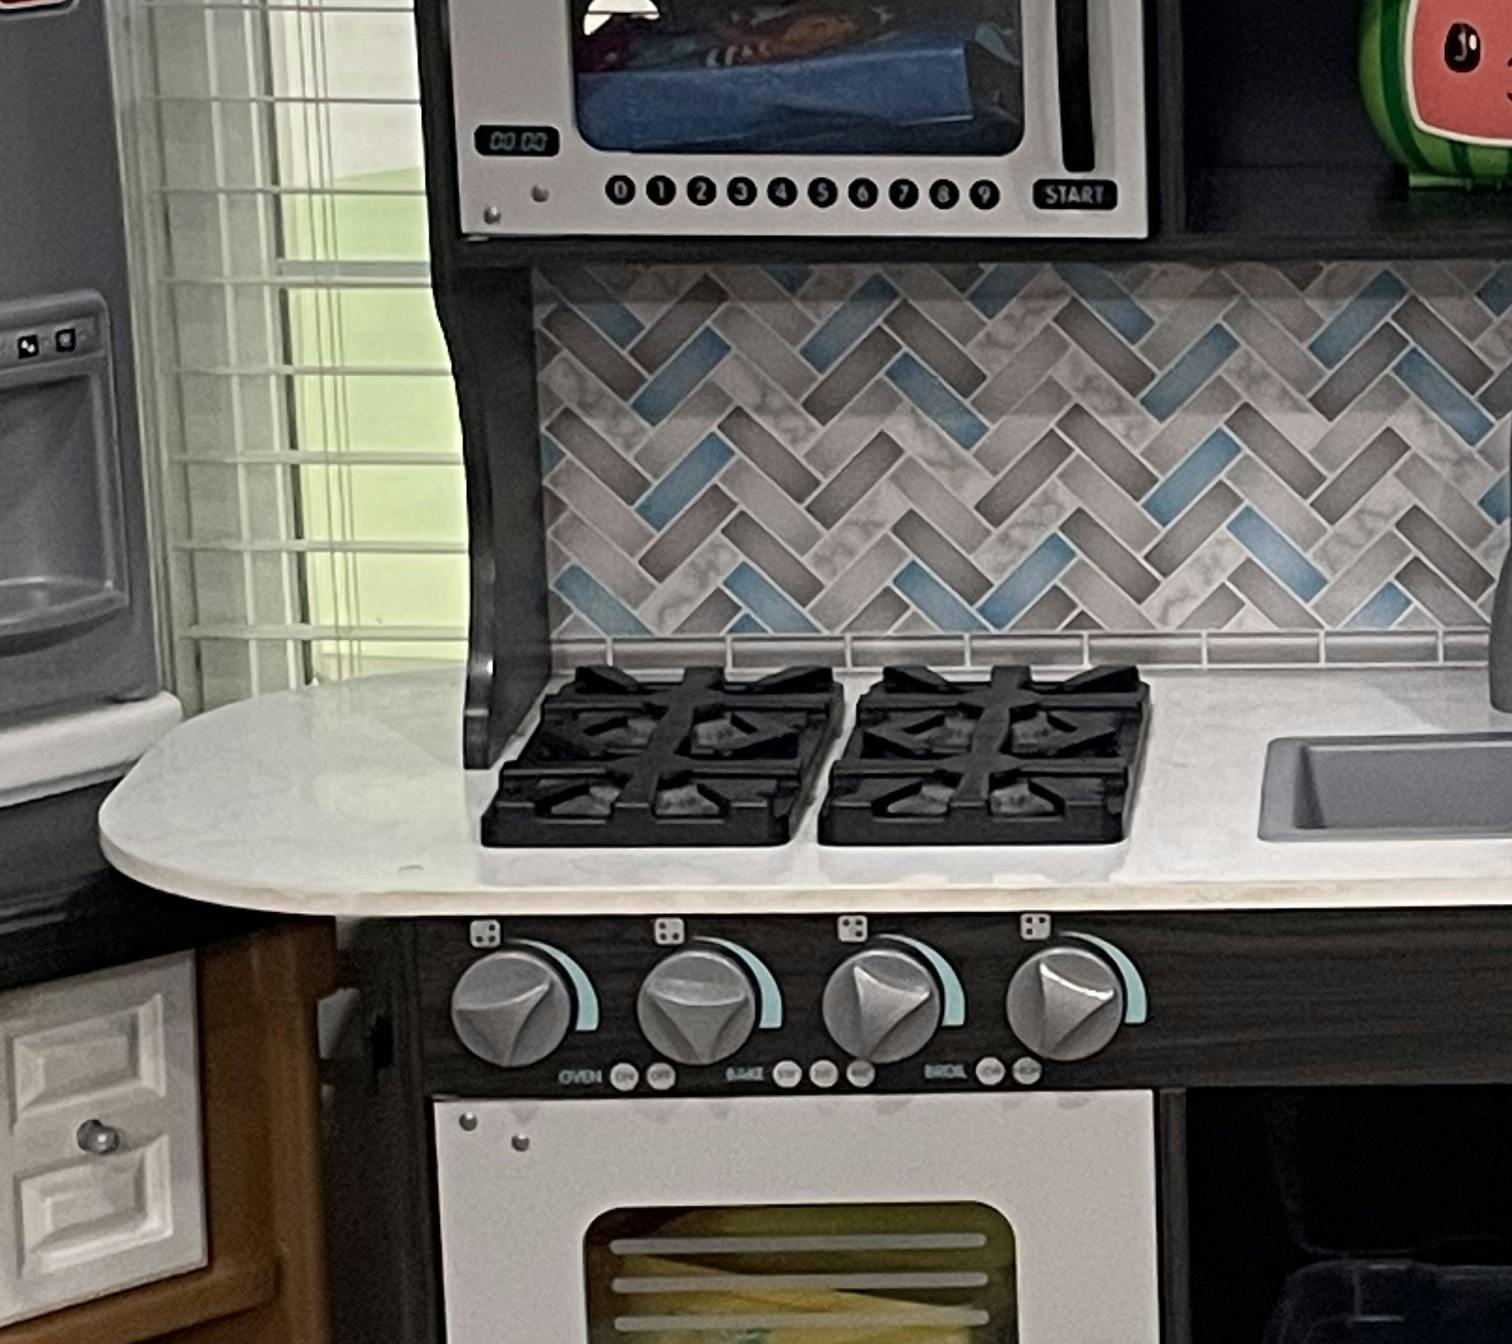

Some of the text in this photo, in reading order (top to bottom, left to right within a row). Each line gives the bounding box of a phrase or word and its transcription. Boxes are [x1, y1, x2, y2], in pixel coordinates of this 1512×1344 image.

[613, 180, 991, 204] 0 1 2 3 4 5 6 7 8 9
[1044, 184, 1105, 205] START
[558, 1068, 603, 1085] OVEN
